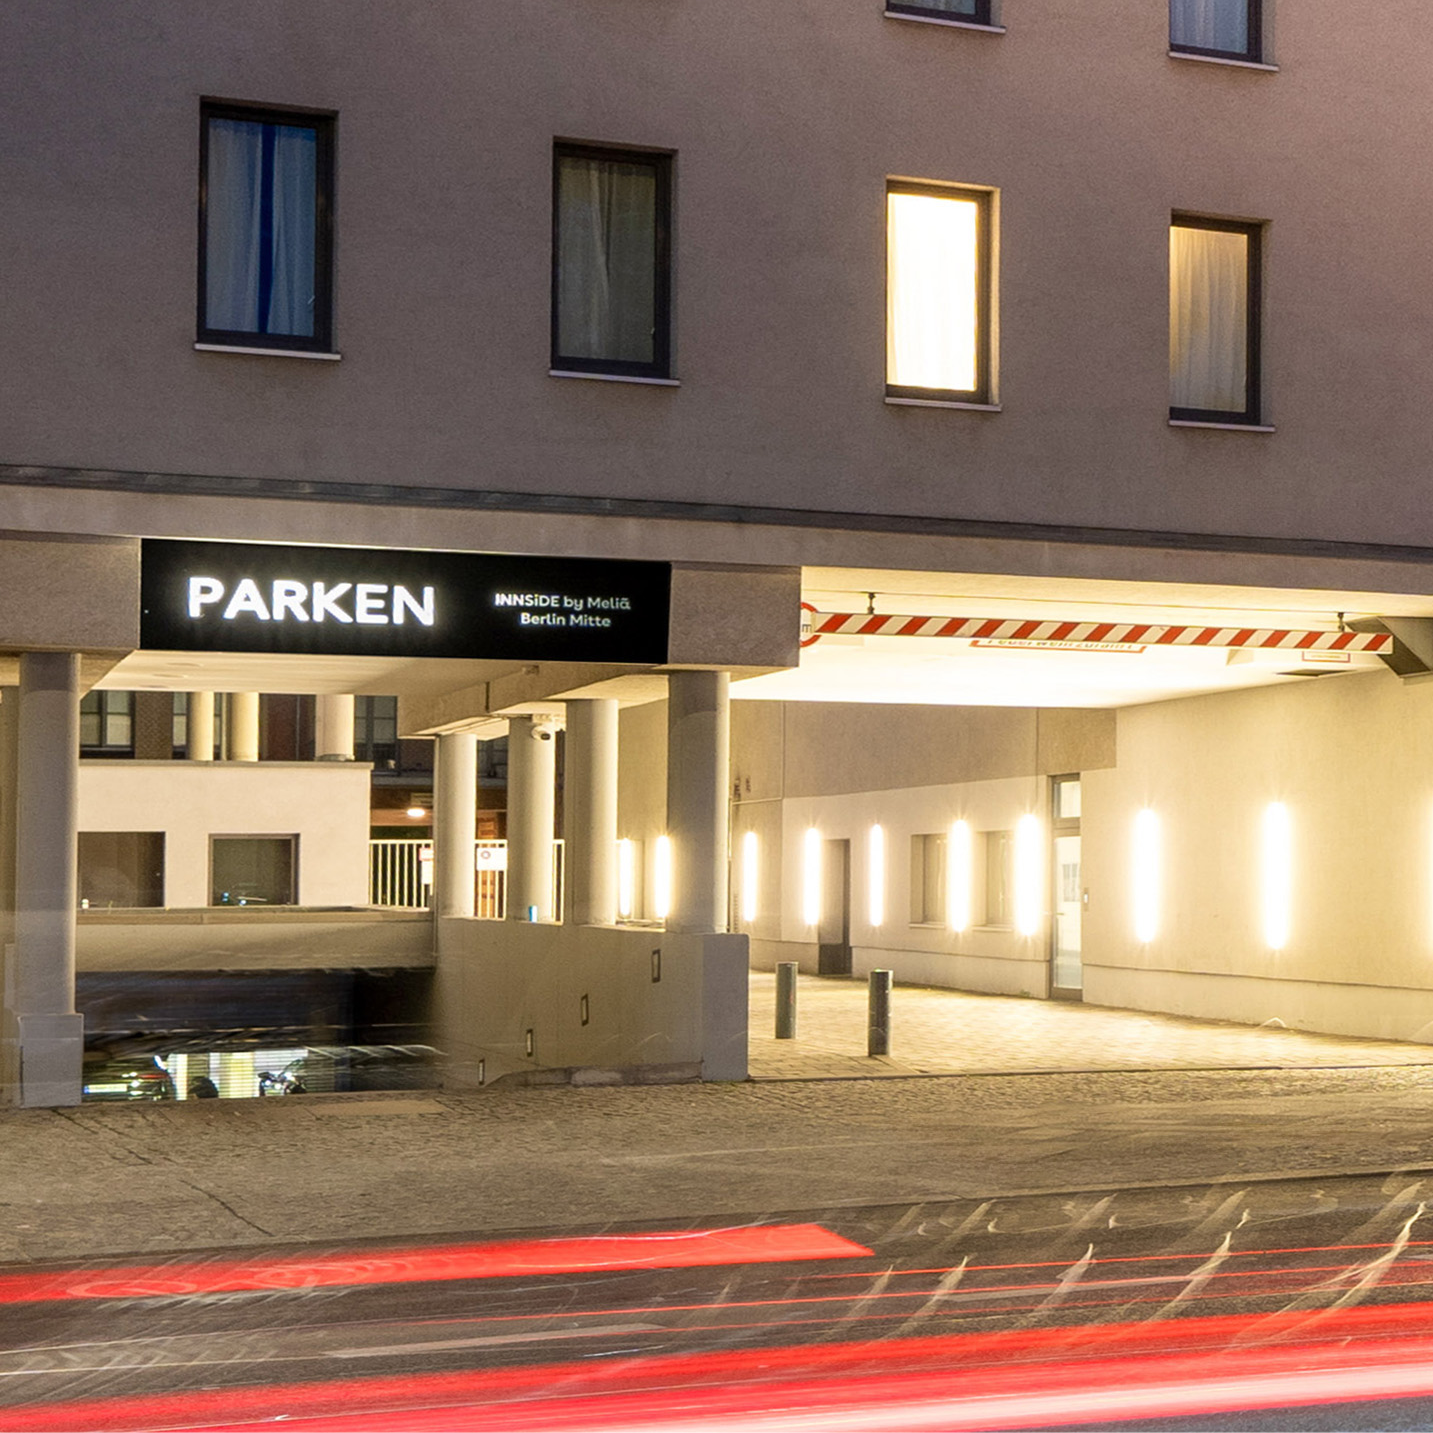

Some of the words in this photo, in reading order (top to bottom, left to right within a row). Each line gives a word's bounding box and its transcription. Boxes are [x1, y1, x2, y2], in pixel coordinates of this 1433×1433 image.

[188, 576, 435, 626] PARKEN
[563, 595, 584, 612] by
[520, 611, 566, 625] Berlin
[569, 614, 612, 627] Mitte
